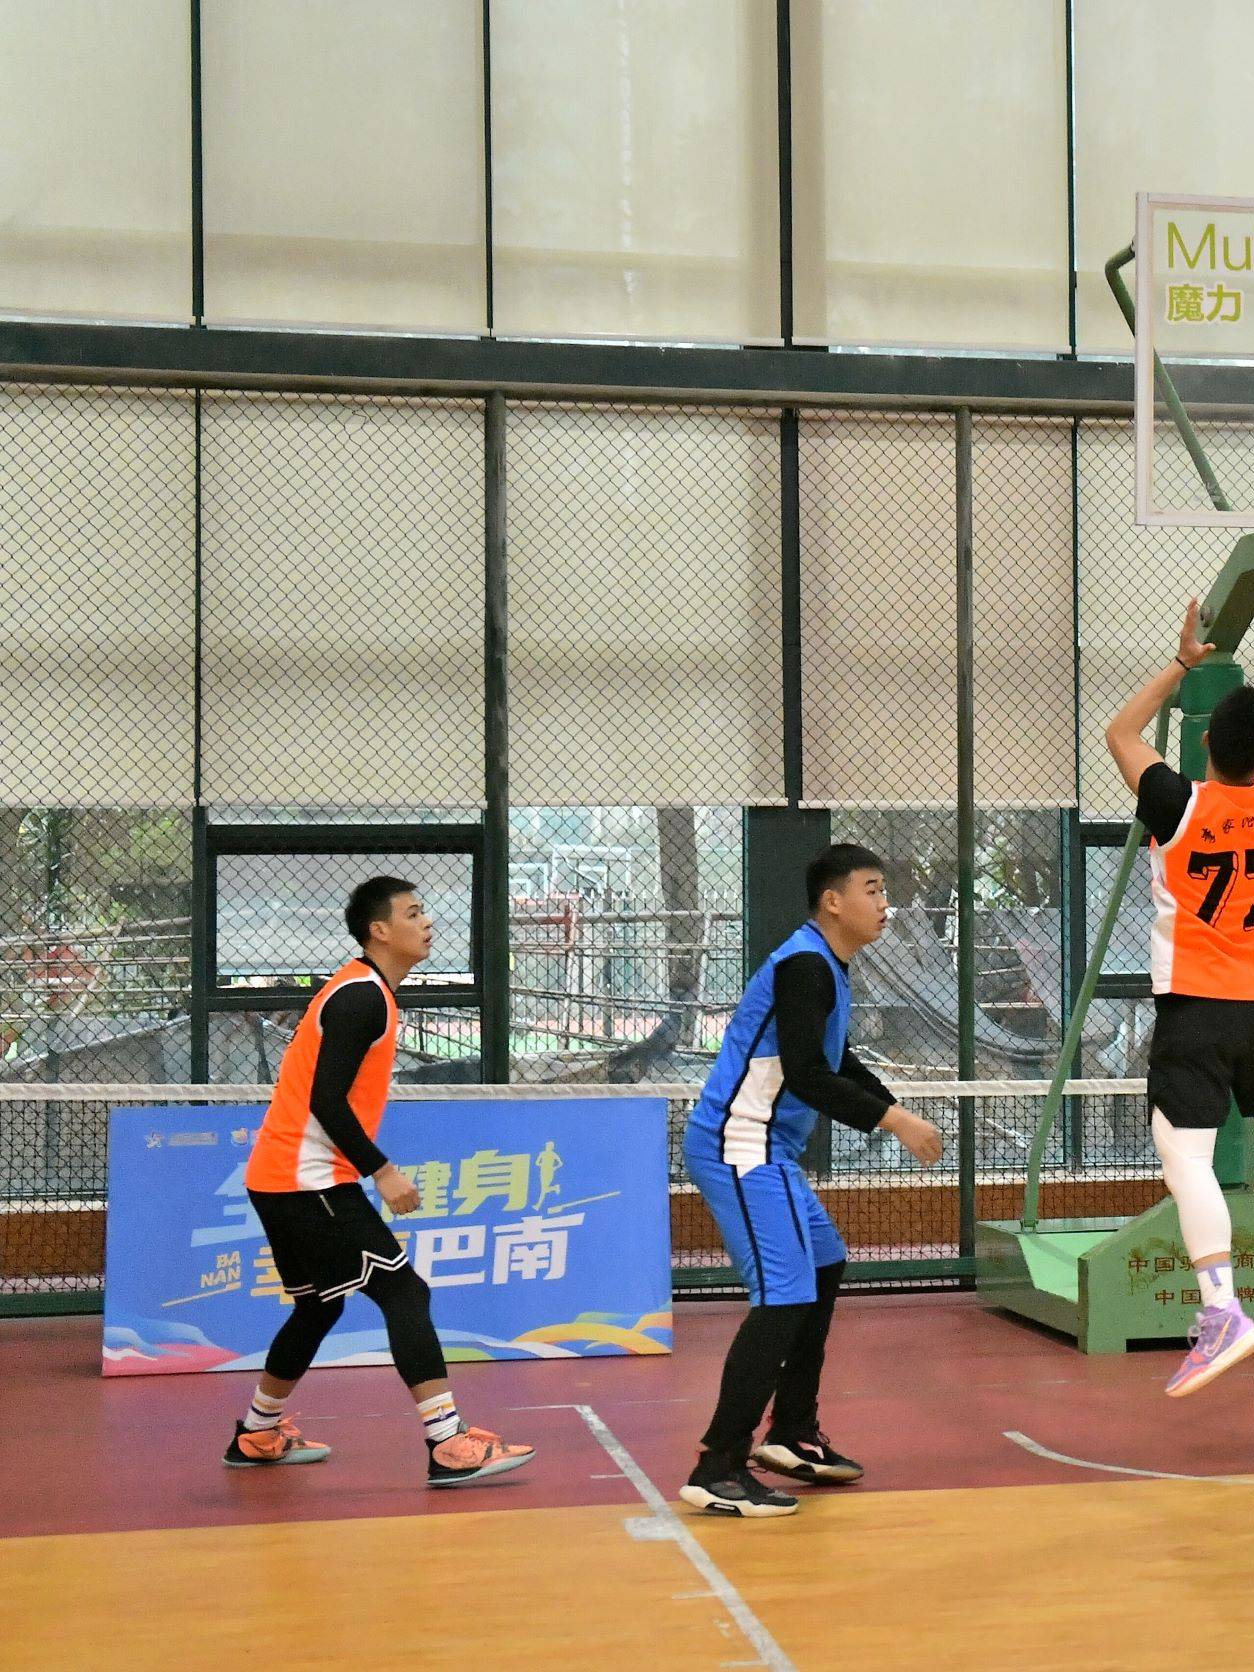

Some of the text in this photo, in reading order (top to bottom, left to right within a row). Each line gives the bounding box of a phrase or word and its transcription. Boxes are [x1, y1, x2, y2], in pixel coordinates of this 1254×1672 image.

[1167, 284, 1242, 322] 魔力
[216, 1251, 241, 1269] BA
[200, 1266, 242, 1288] NAN
